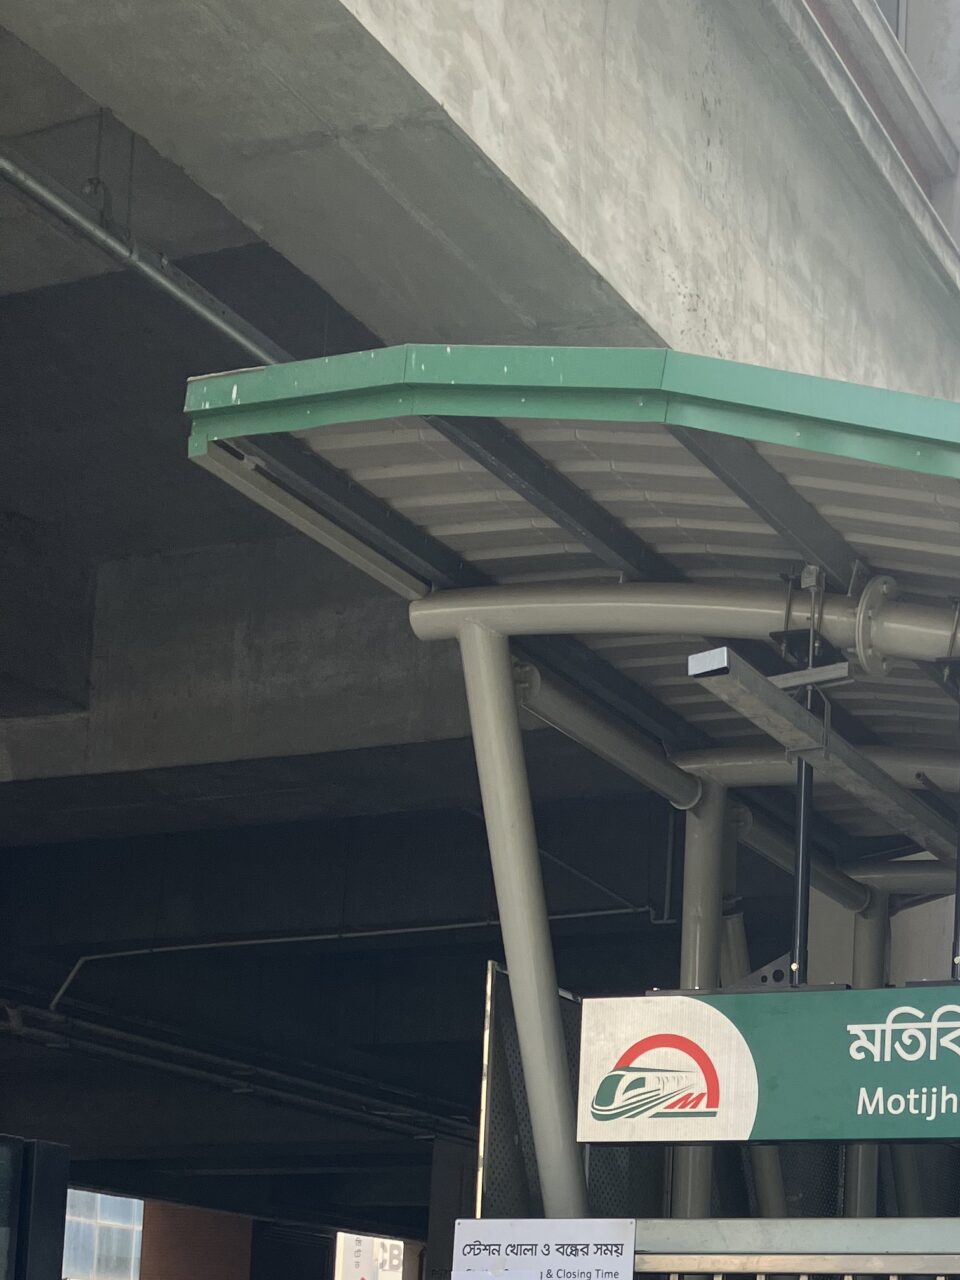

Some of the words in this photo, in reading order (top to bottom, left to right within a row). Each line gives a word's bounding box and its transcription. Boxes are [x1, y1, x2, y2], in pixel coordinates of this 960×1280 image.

[462, 1240, 502, 1257] স্টেশন
[504, 1243, 538, 1257] খোলা
[541, 1243, 551, 1257] ও
[555, 1243, 590, 1258] বন্ধের
[593, 1243, 625, 1258] সময়
[545, 1269, 554, 1279] &
[556, 1268, 592, 1280] Closing
[595, 1268, 620, 1279] Time
